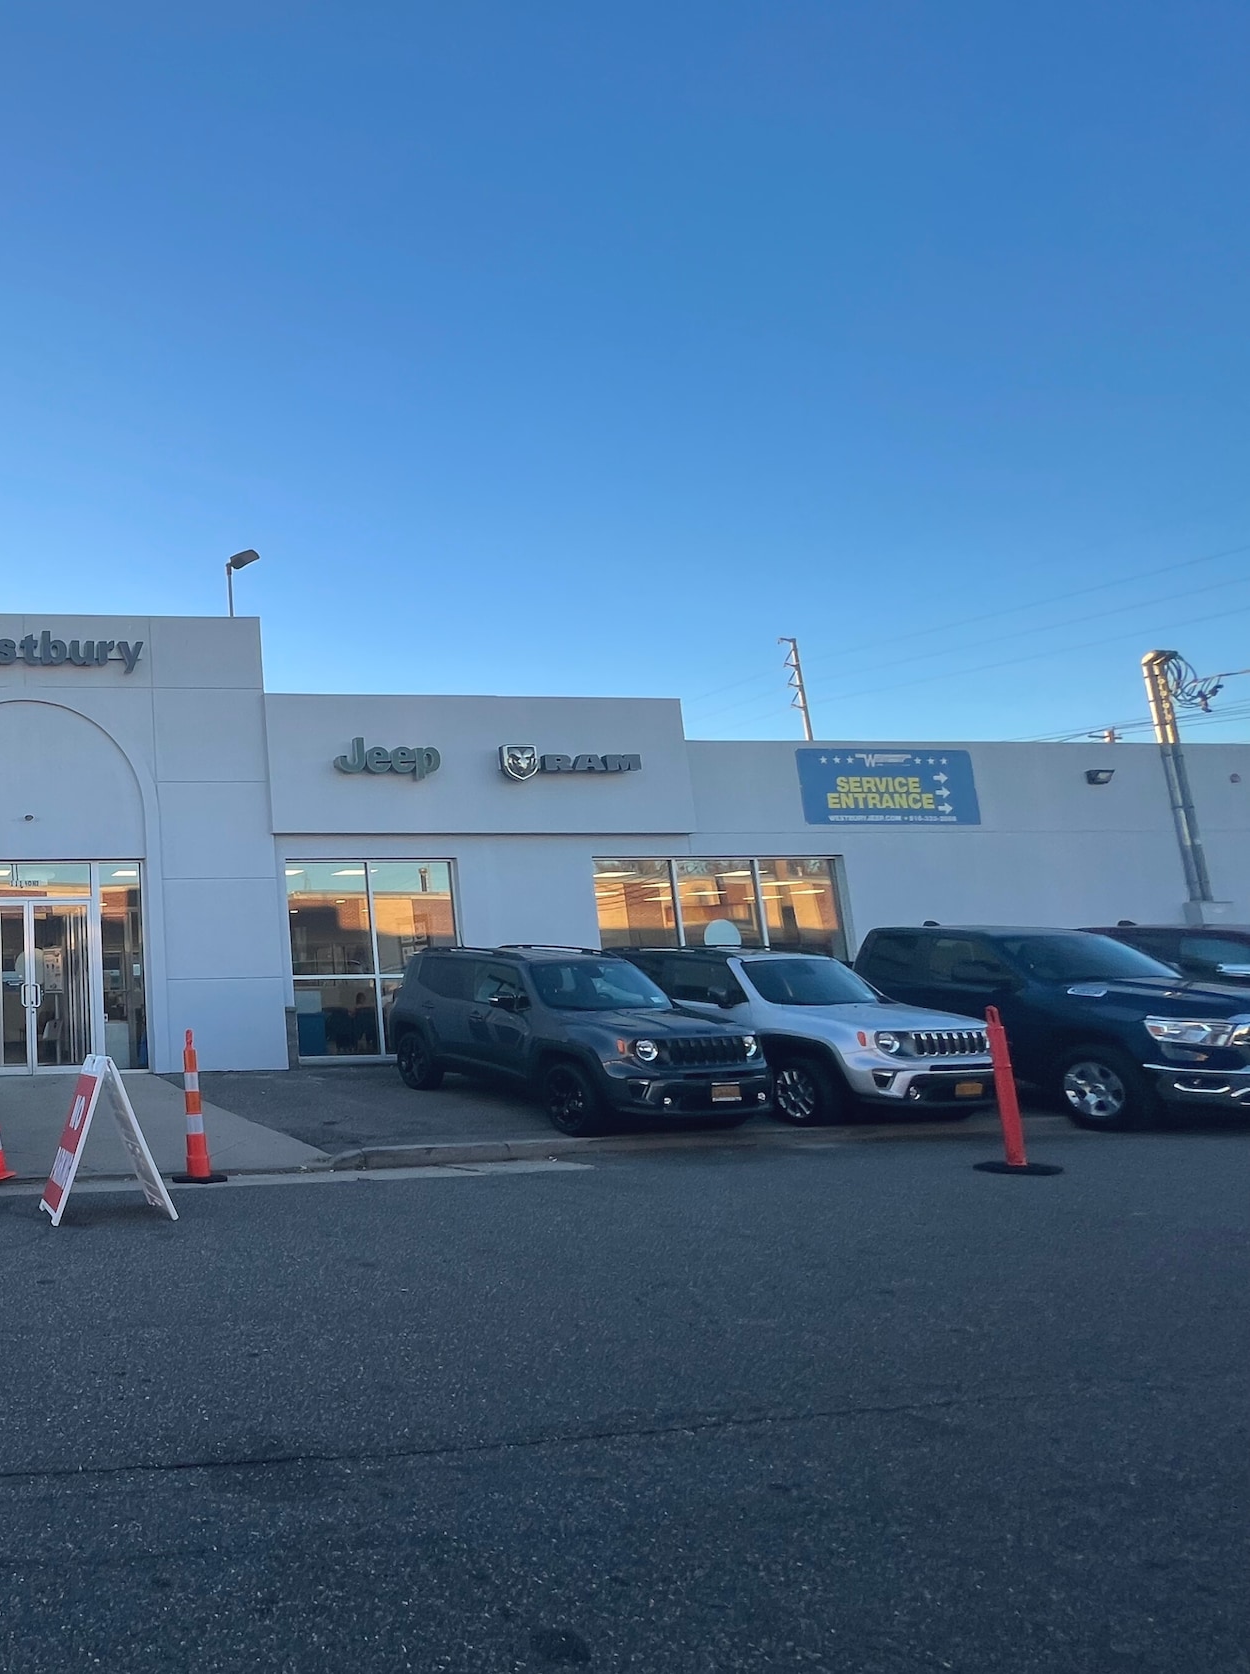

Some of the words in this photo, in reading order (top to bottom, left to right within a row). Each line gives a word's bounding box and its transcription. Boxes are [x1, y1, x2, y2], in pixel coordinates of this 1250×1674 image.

[333, 736, 441, 782] Jeep
[540, 753, 642, 773] RAM
[836, 776, 922, 793] SERVICE
[826, 792, 936, 810] ENTRANCE
